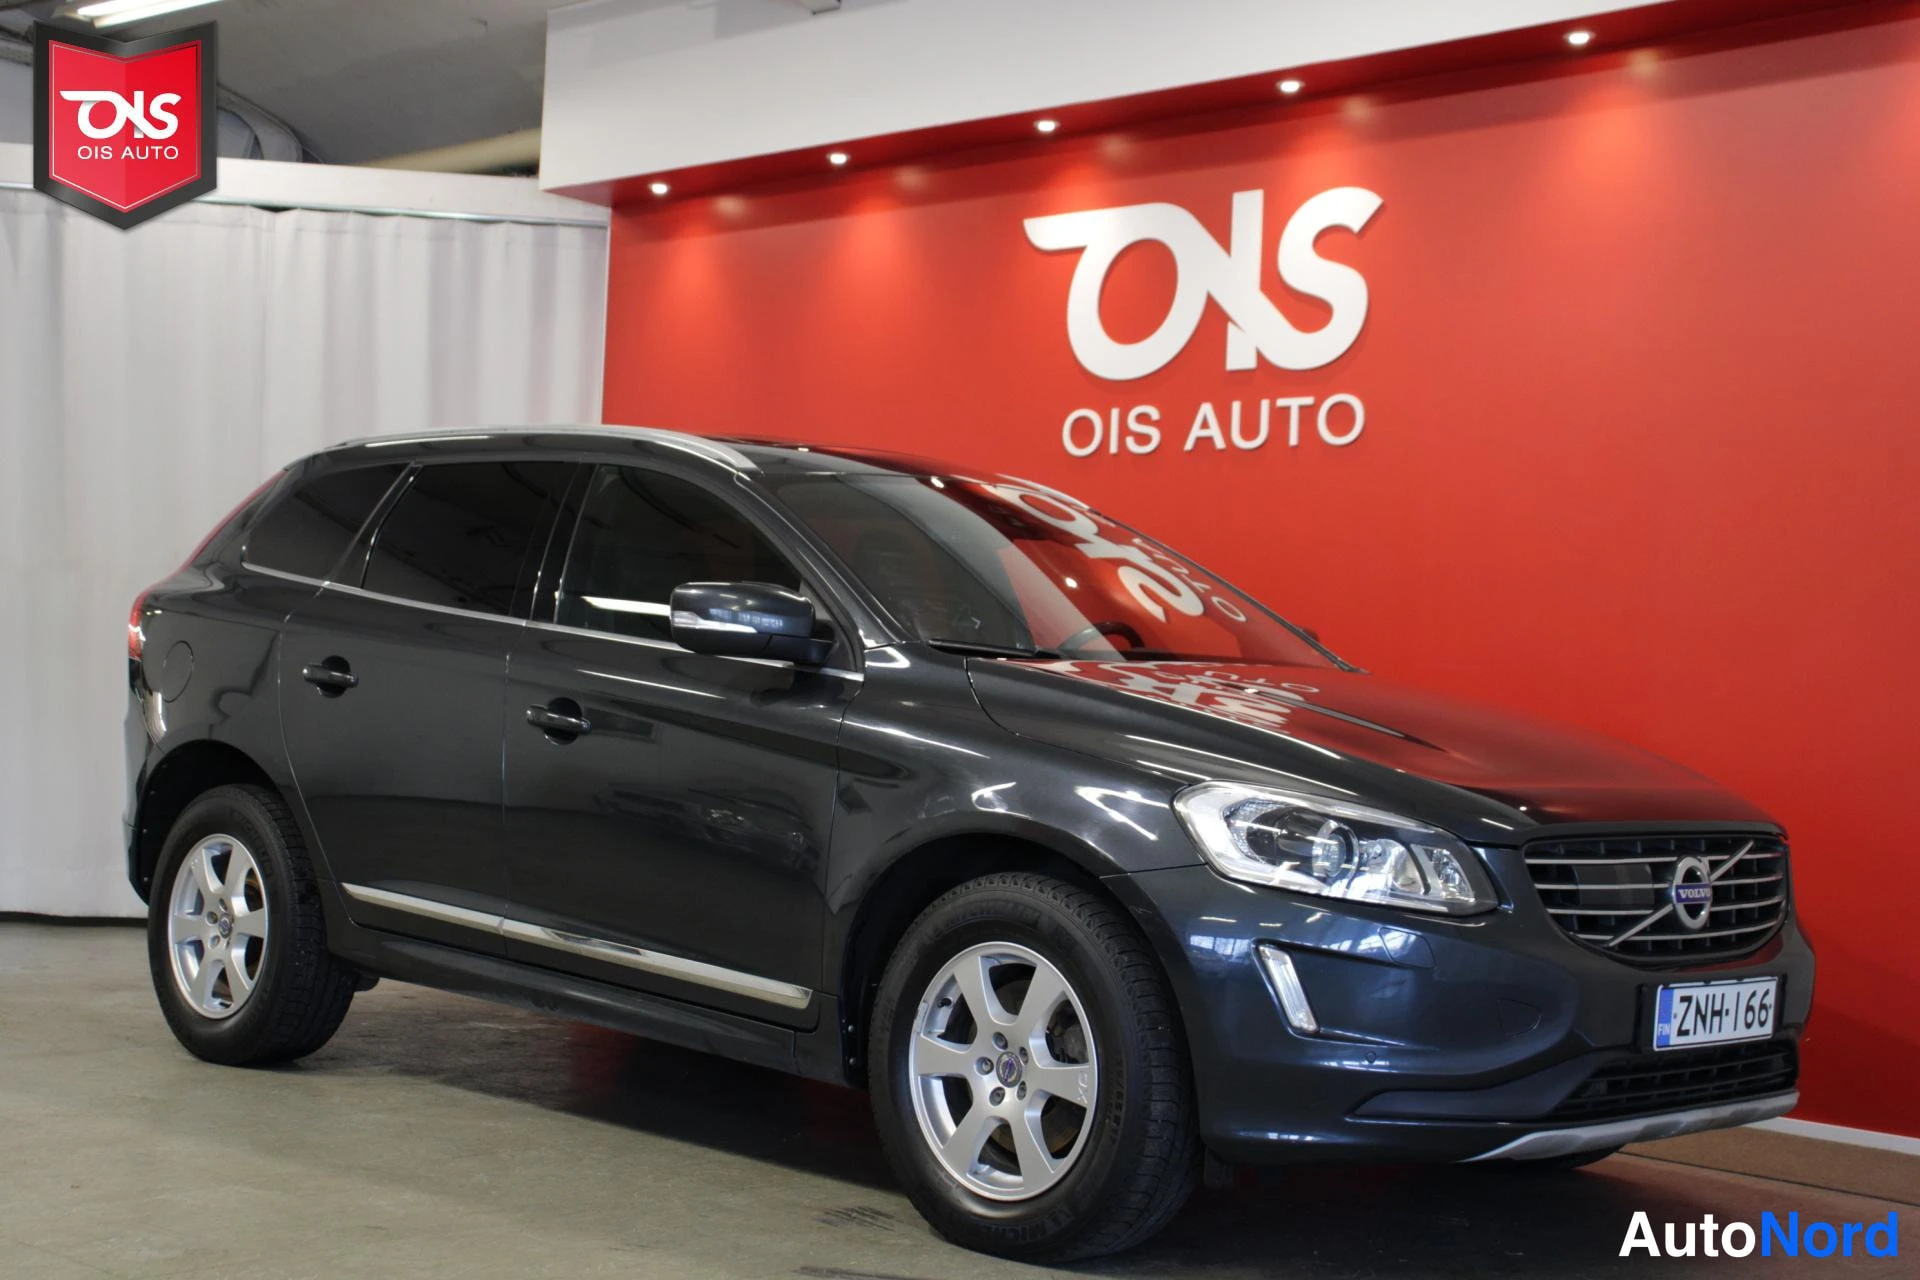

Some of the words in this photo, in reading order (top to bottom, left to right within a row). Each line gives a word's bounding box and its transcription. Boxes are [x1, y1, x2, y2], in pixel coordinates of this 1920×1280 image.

[1062, 405, 1161, 457] OIS
[1184, 393, 1365, 452] AUTO
[1678, 888, 1712, 899] VOLVO
[1677, 988, 1771, 1037] ZNH-166
